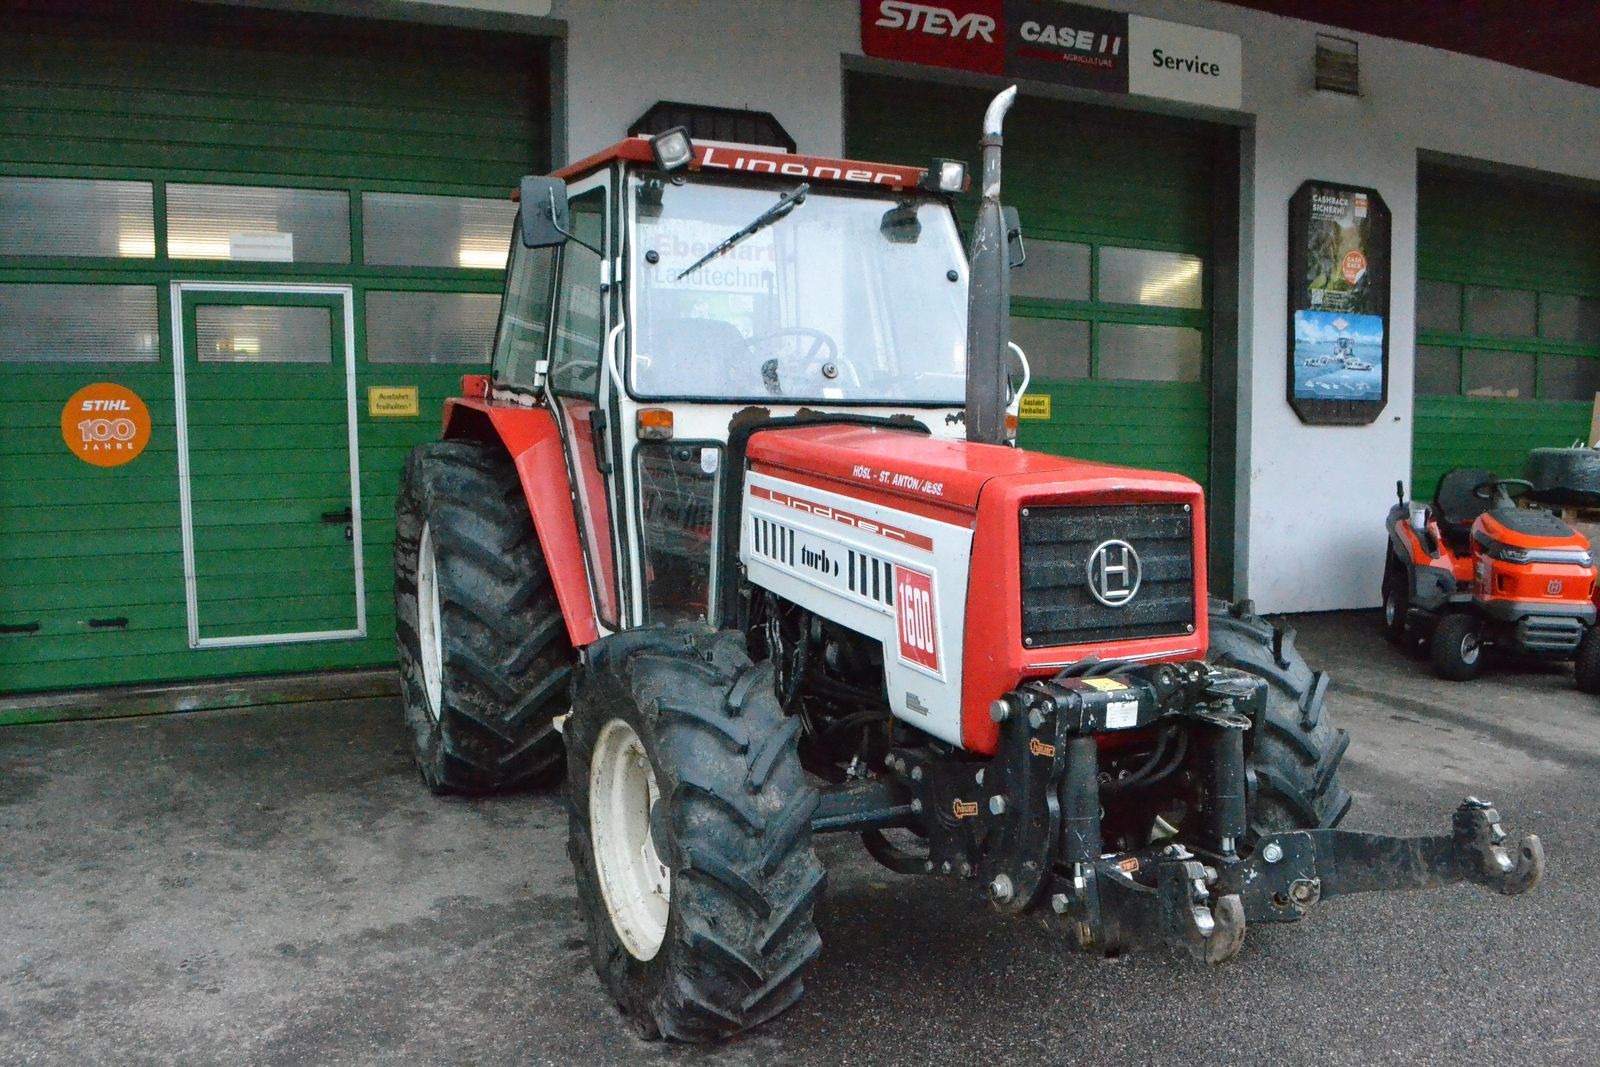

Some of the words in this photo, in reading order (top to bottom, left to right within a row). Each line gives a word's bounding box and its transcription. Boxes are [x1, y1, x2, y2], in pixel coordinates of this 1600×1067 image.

[875, 0, 996, 43] STEYR
[1020, 21, 1094, 51] CASE
[1063, 53, 1112, 68] AGRICULTURE
[1152, 48, 1220, 77] Service
[81, 399, 131, 411] STIHL
[77, 418, 136, 441] 100
[83, 443, 134, 451] JAHRE
[879, 470, 890, 484] ST.
[769, 490, 905, 539] Lindner
[899, 581, 934, 654] 1600
